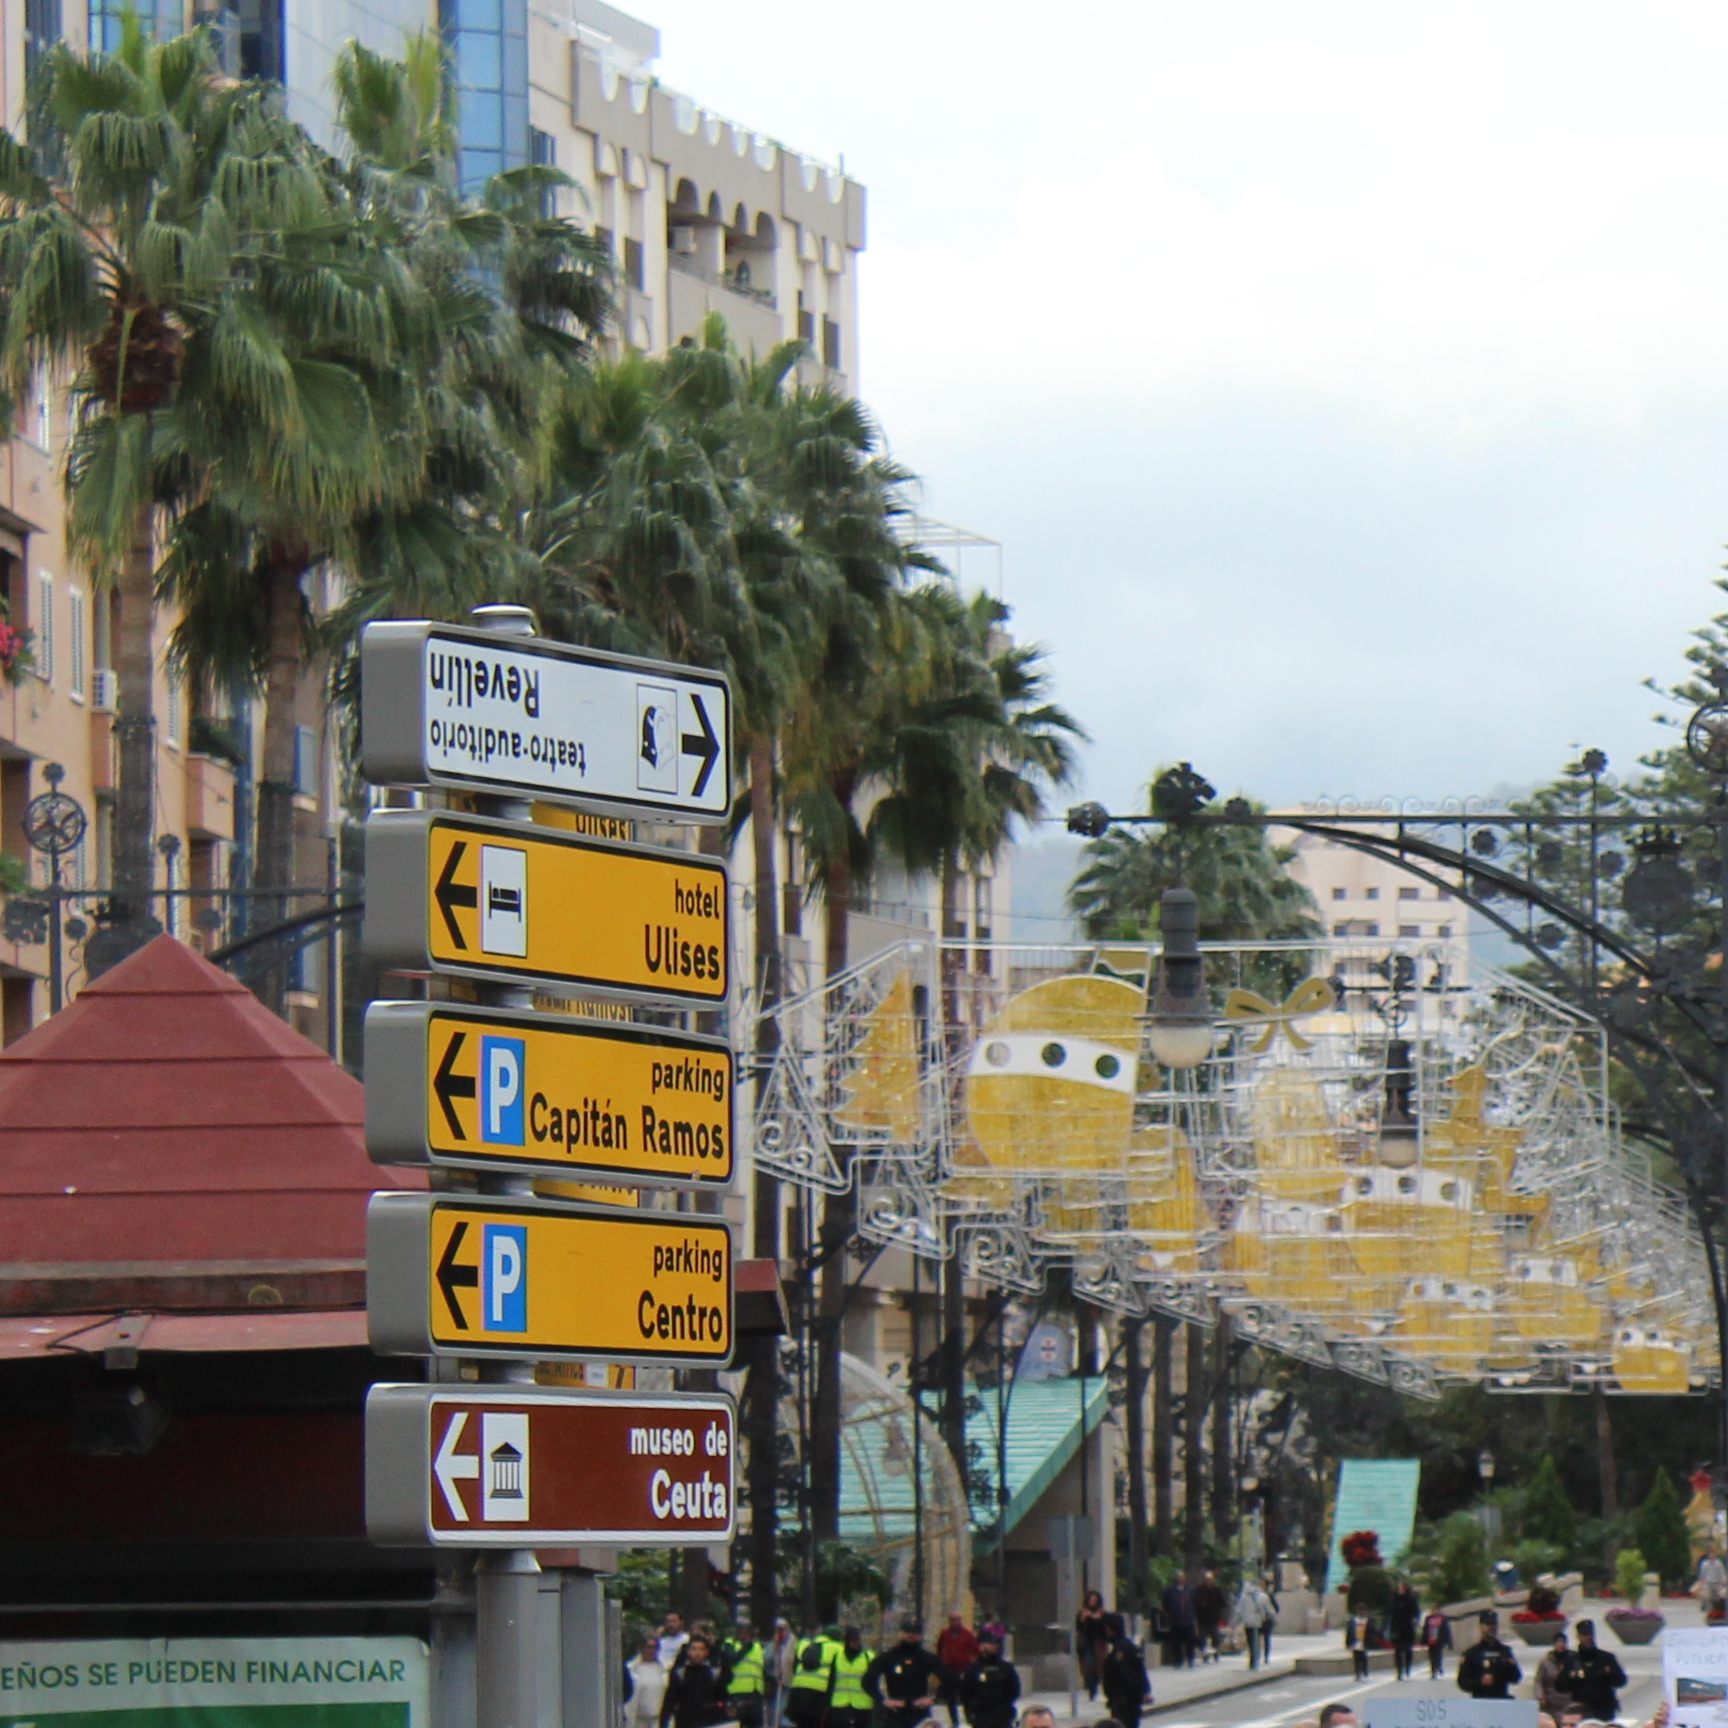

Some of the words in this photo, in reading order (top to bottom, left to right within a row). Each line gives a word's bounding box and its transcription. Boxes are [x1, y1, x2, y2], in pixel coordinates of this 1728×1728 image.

[430, 652, 539, 719] Revellín
[674, 879, 721, 921] hotel
[644, 924, 721, 981] Ulises
[651, 1057, 725, 1100] parking
[529, 1092, 628, 1154] Capitán
[641, 1106, 725, 1159] Ramos
[653, 1239, 724, 1282] parking
[637, 1289, 724, 1343] Centro
[629, 1425, 695, 1457] museo
[704, 1421, 728, 1457] de
[650, 1467, 728, 1520] Ceuta
[88, 1662, 119, 1687] SE
[129, 1659, 236, 1686] PUEDEN
[246, 1659, 406, 1685] FINANCIAR
[1416, 1699, 1448, 1721] SOS
